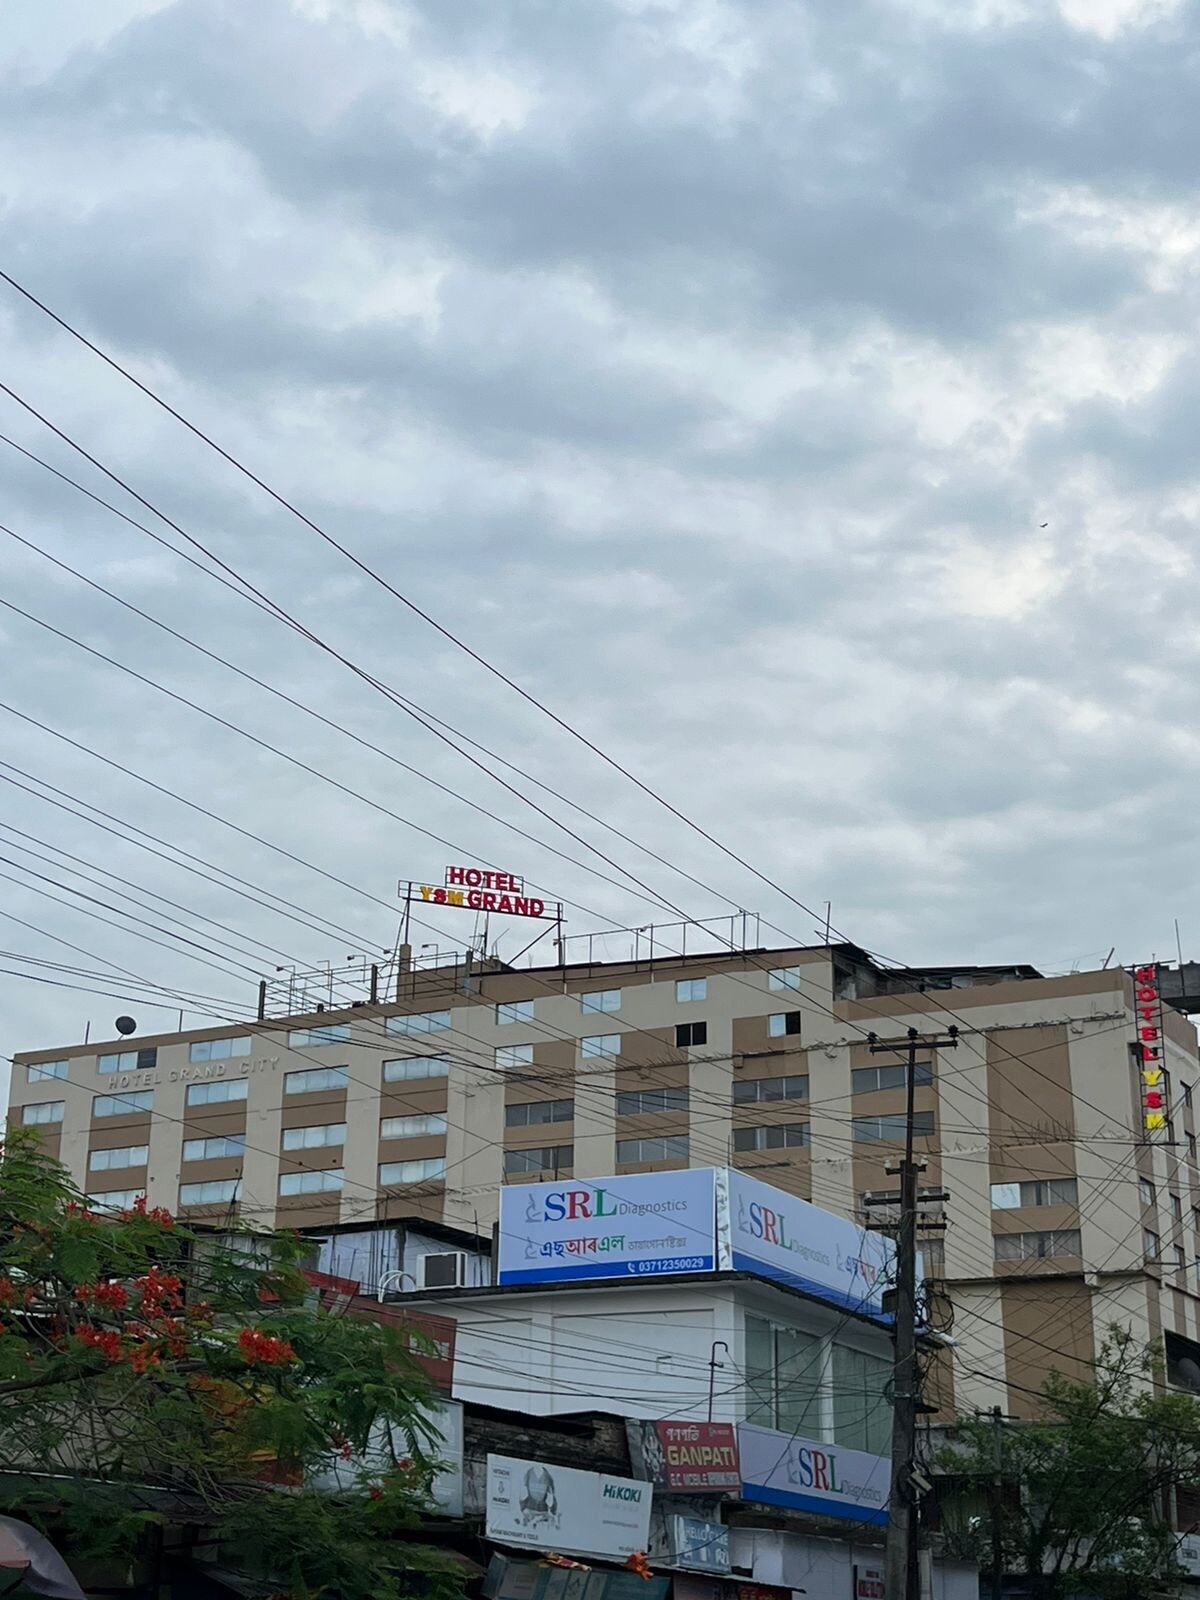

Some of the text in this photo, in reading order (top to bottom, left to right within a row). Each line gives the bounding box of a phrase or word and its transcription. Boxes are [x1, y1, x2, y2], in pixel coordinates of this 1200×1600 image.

[450, 866, 520, 892] HOTEL
[467, 889, 544, 917] GRAND
[1136, 966, 1159, 1061] HOTEL
[108, 1056, 280, 1090] HOTEL GRAND CITY
[544, 1188, 688, 1222] SRL Diagnostics
[749, 1202, 792, 1251] SRL
[638, 1258, 704, 1273] 03712350029
[667, 1445, 736, 1466] GANPATI
[799, 1448, 843, 1494] SRL
